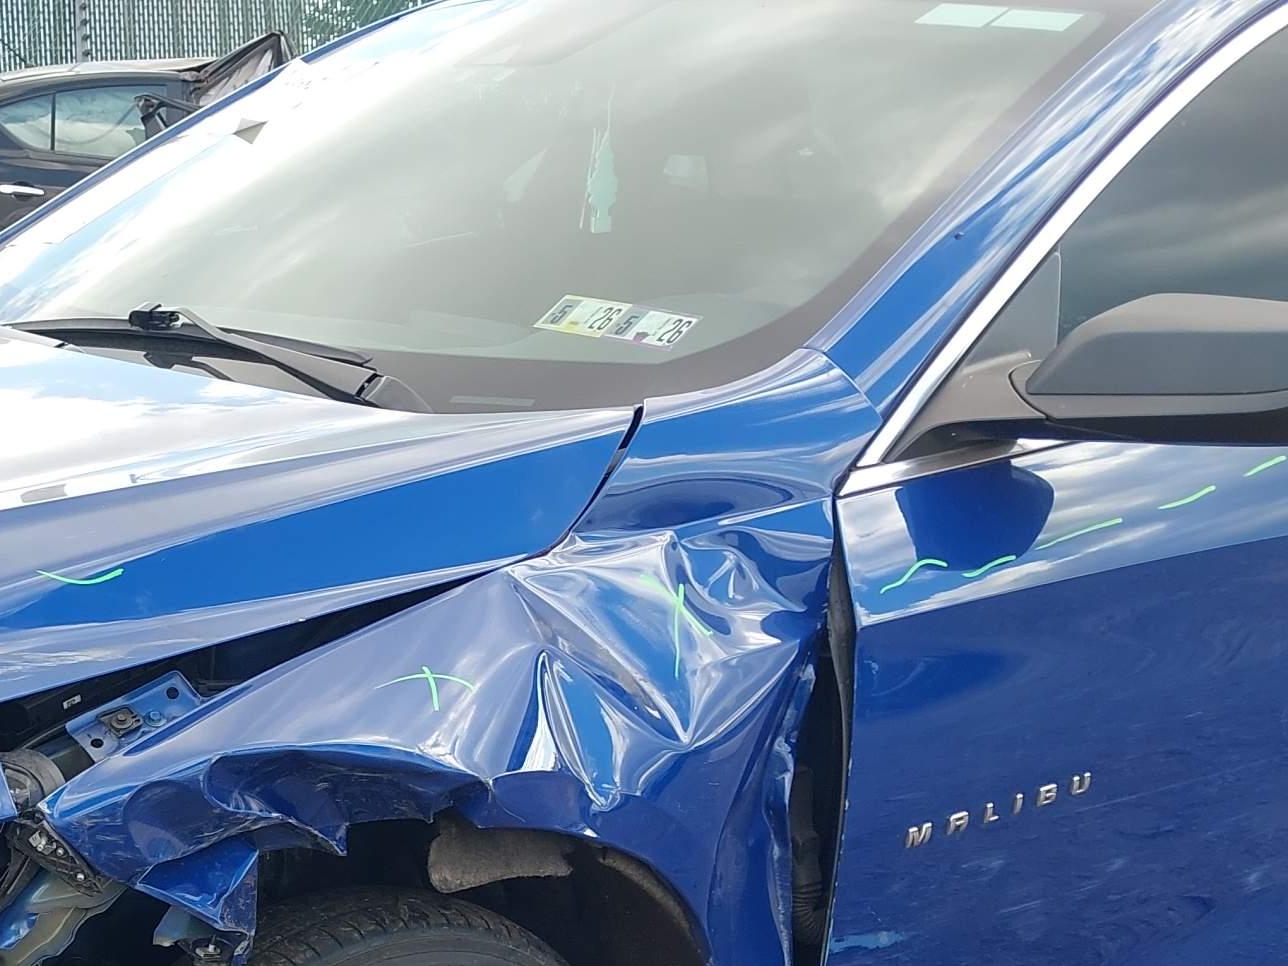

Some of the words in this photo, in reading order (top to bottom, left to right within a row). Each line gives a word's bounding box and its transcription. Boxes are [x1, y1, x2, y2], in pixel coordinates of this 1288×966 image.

[588, 307, 623, 330] 26
[656, 318, 693, 344] 26
[905, 772, 1091, 849] MALIBU
